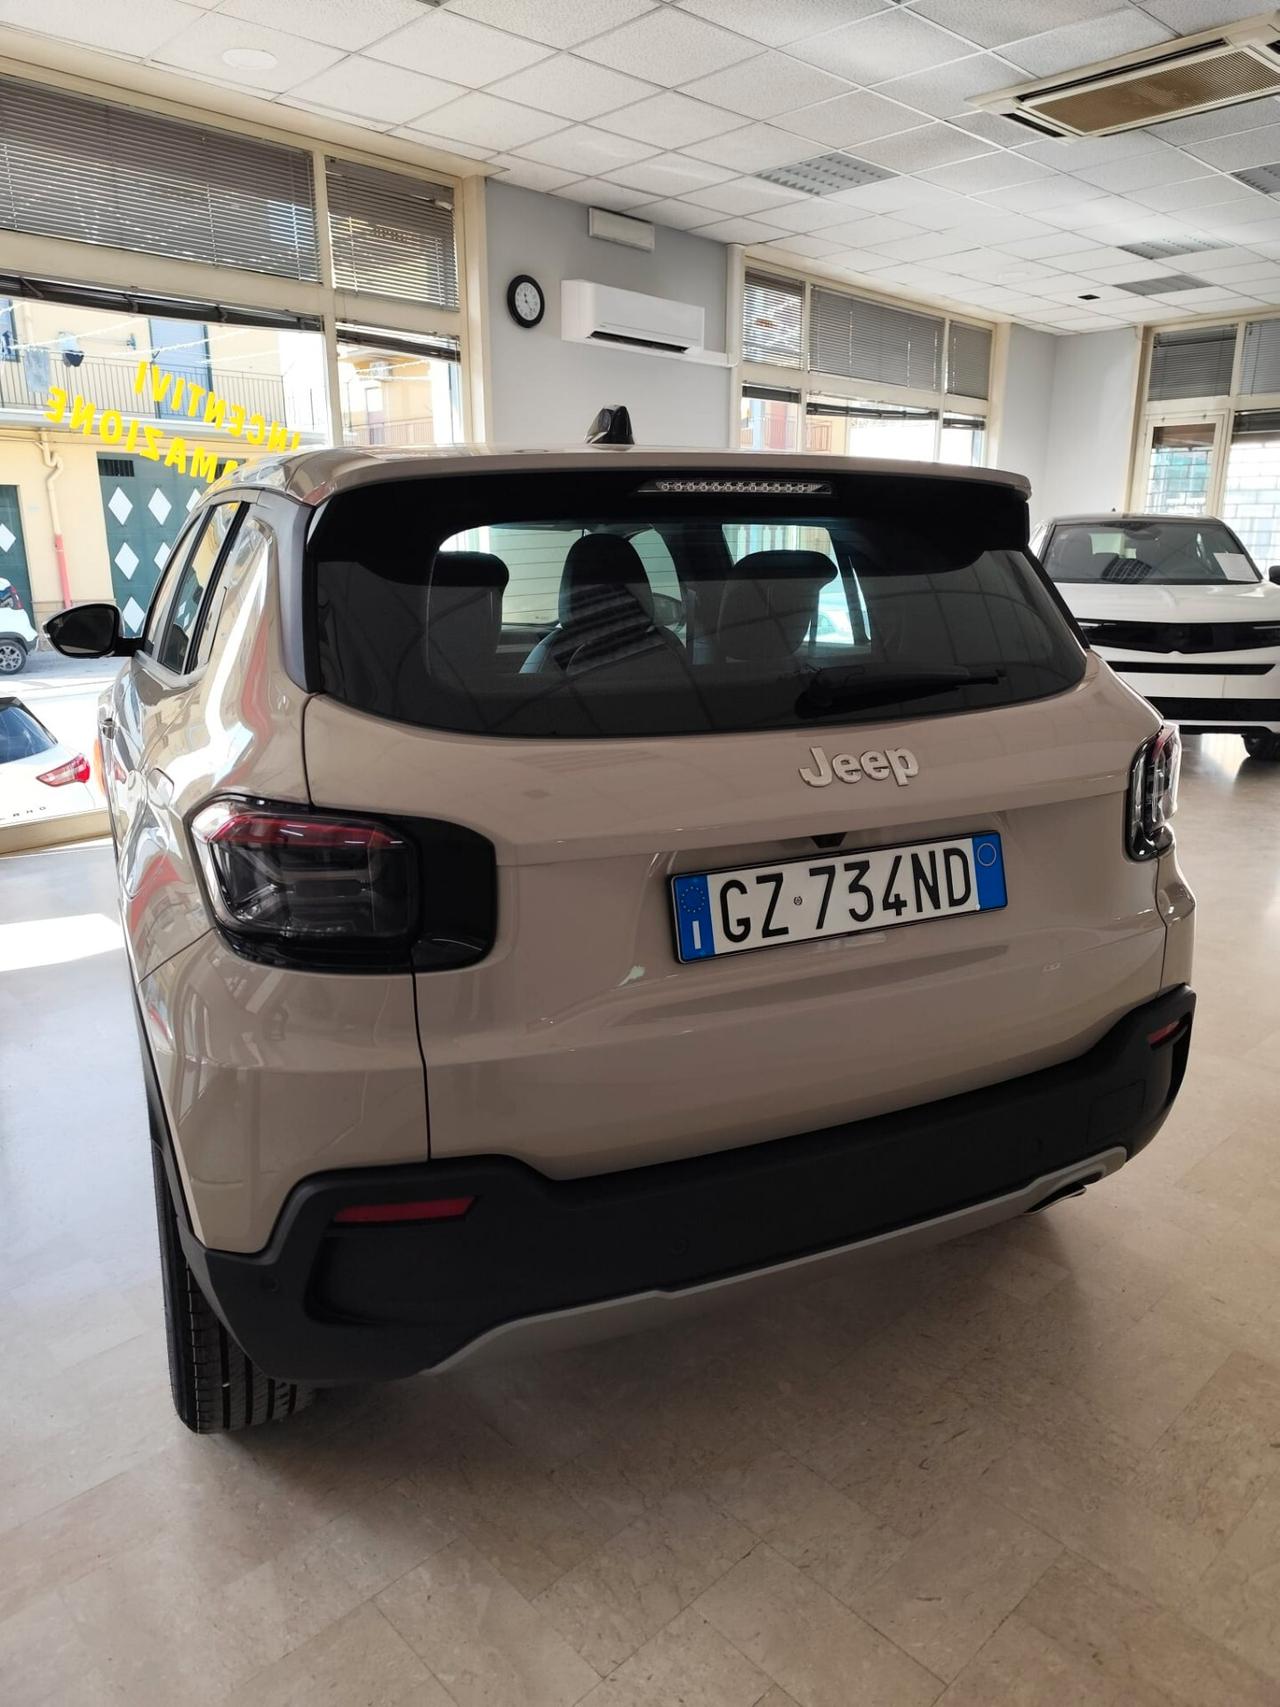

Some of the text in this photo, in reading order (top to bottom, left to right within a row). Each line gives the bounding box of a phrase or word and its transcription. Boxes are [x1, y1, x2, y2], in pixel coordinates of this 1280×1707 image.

[799, 746, 919, 788] Jeep
[691, 847, 972, 950] I GZ 734ND
